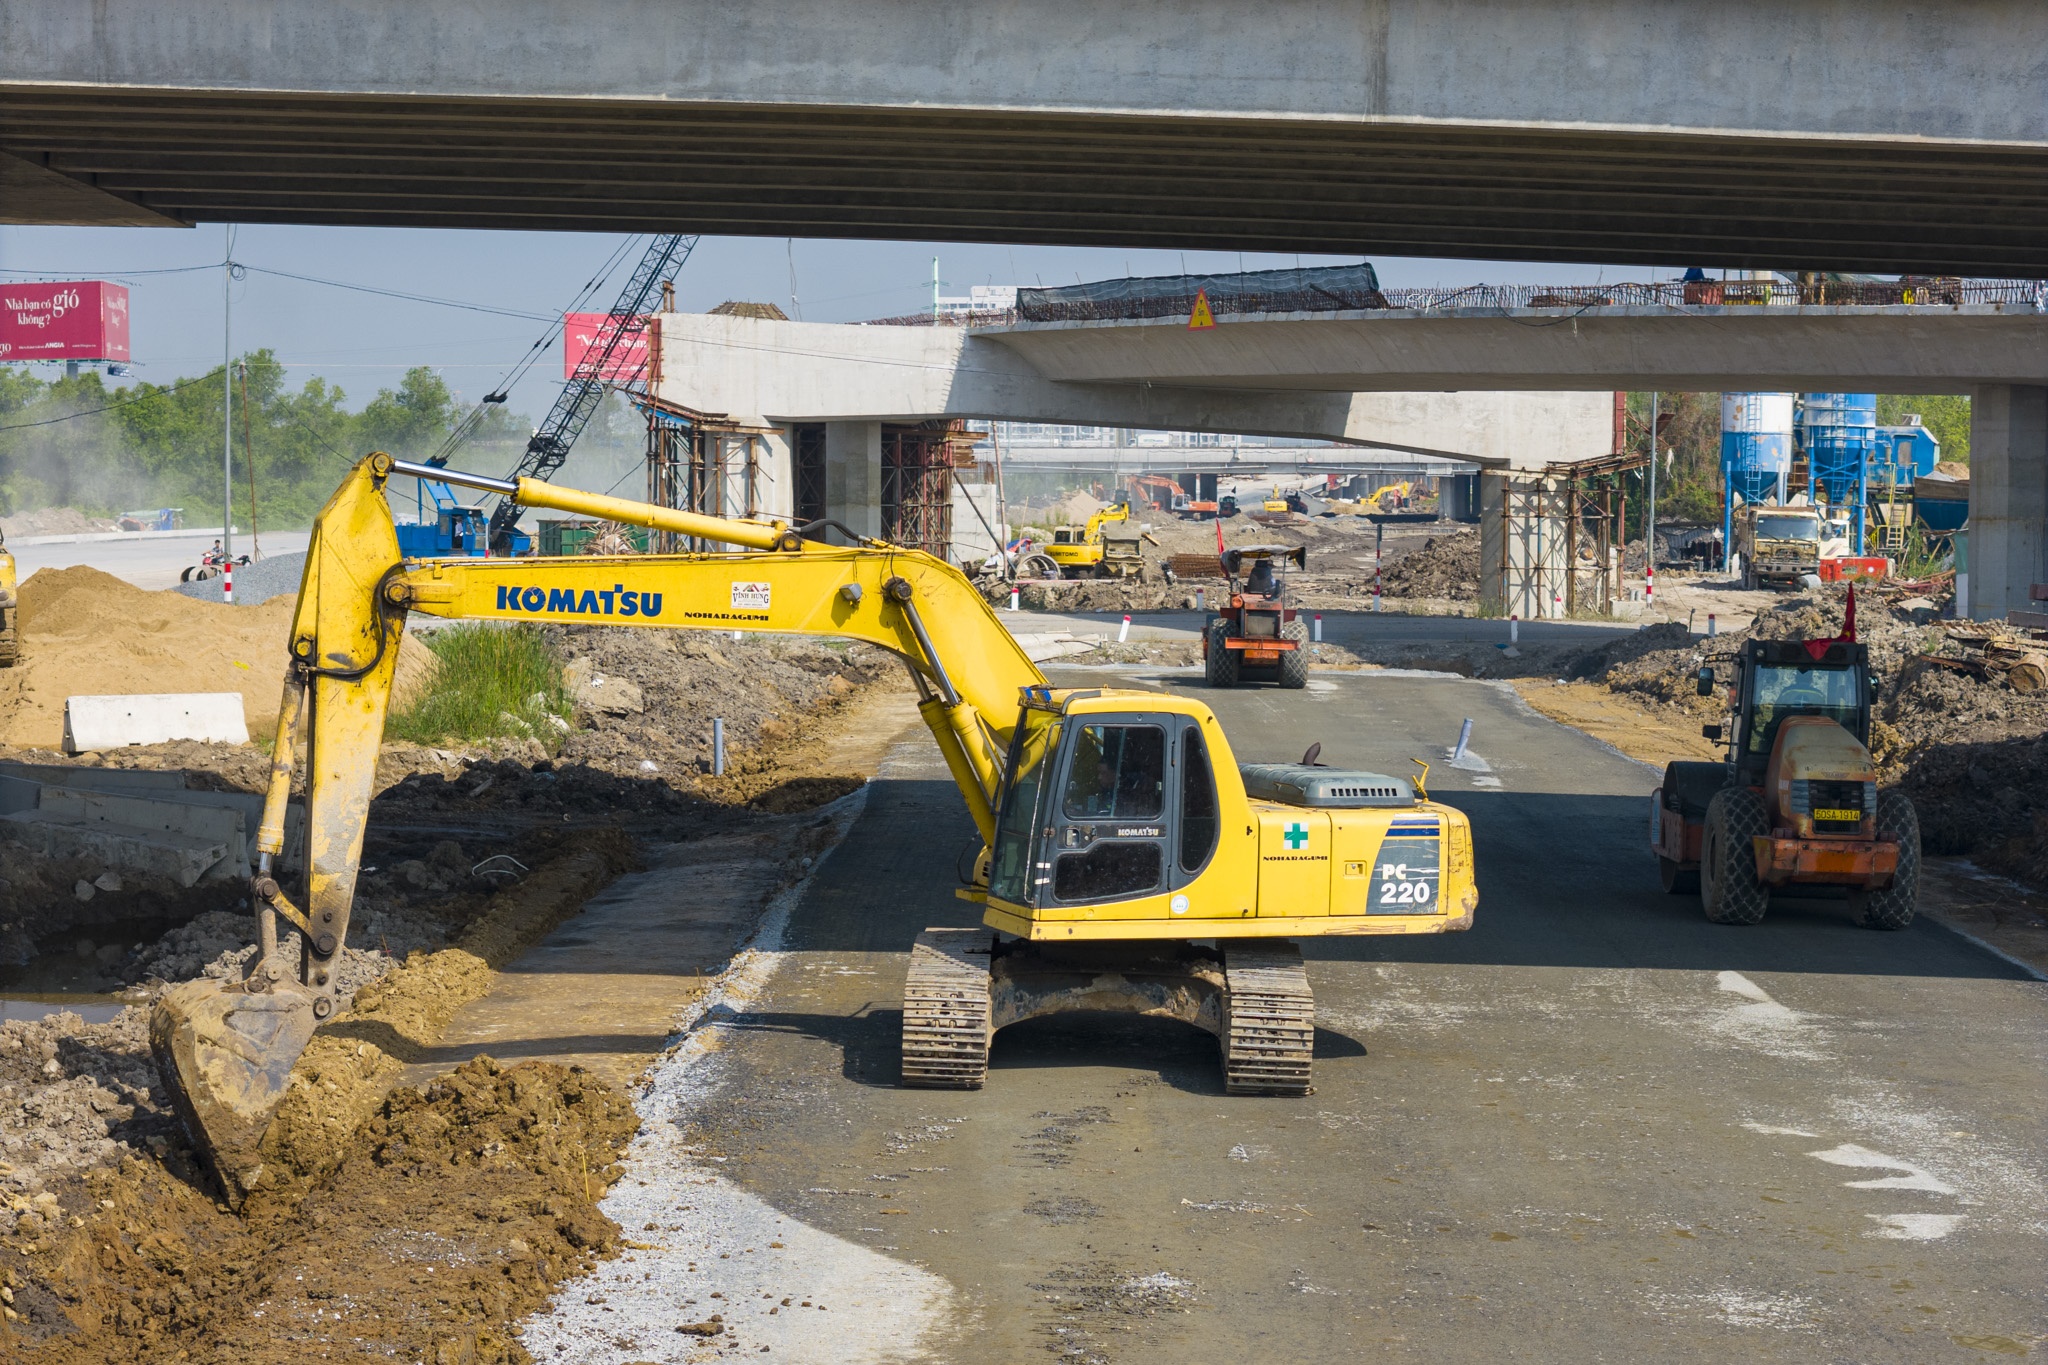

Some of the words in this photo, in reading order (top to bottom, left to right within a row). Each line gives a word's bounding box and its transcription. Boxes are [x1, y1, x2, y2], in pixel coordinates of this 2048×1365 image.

[5, 298, 21, 310] Nhà
[24, 298, 40, 312] bạn
[41, 299, 51, 310] có
[53, 289, 79, 318] gió
[496, 584, 662, 617] KOMATSU
[684, 612, 769, 621] NOHARAGUMI
[1118, 827, 1159, 837] KOMATSU
[1382, 863, 1407, 880] PC
[1380, 882, 1430, 904] 220
